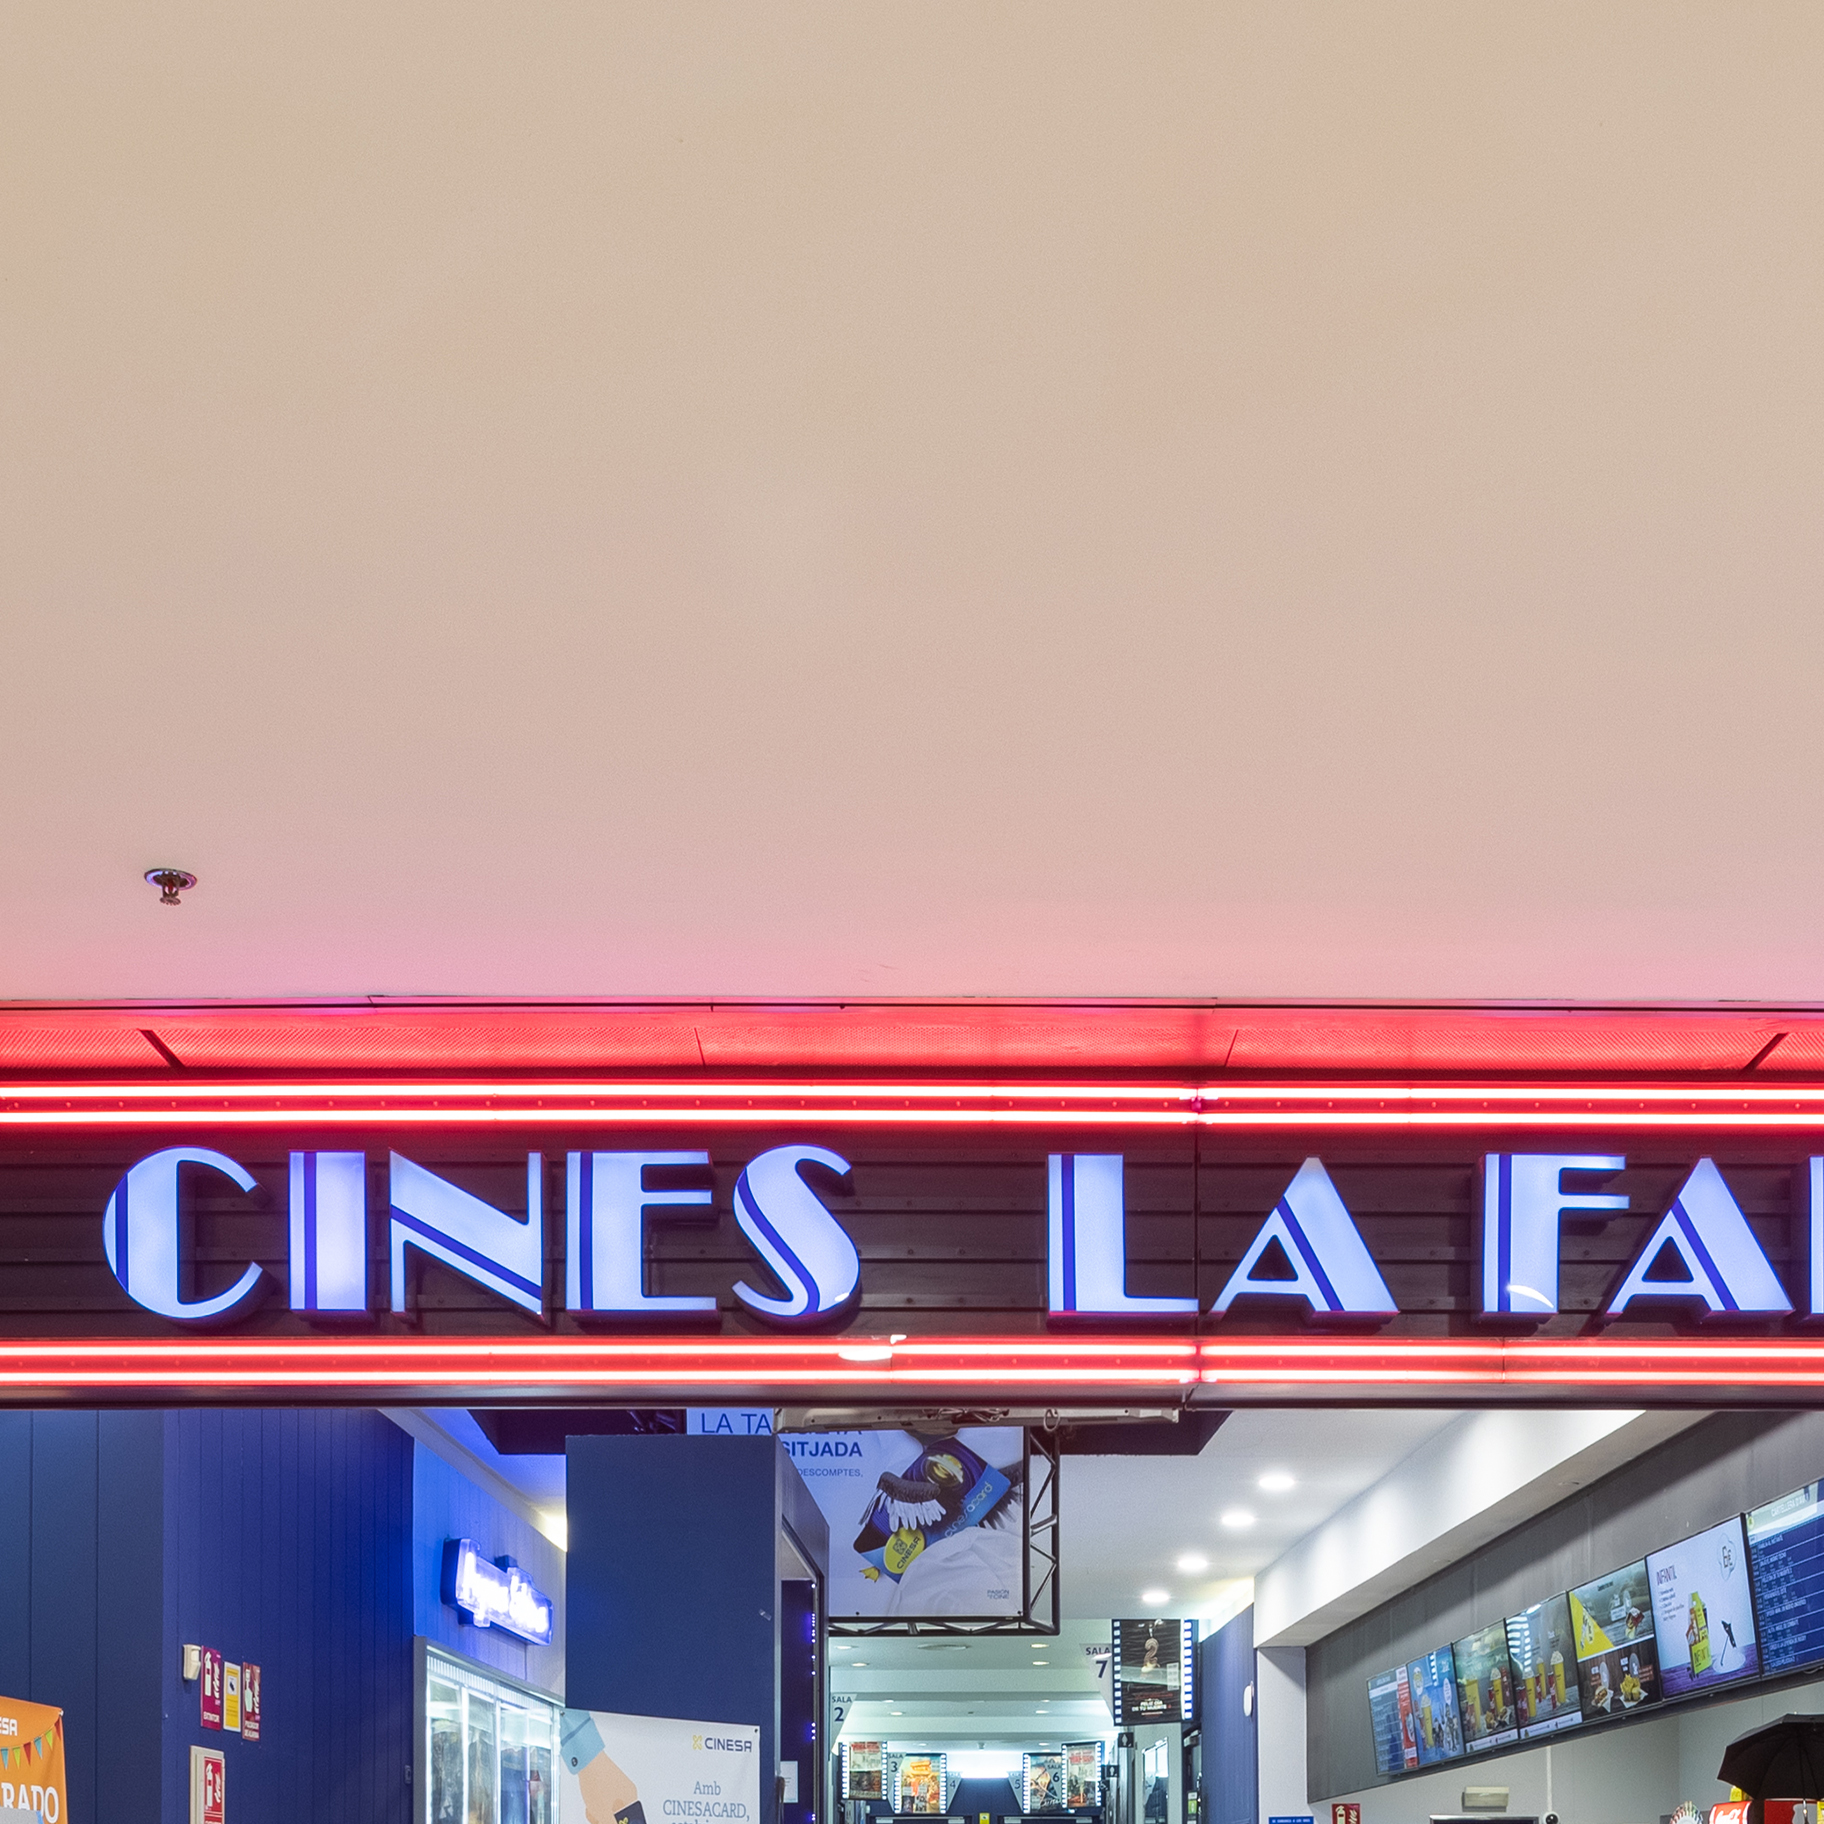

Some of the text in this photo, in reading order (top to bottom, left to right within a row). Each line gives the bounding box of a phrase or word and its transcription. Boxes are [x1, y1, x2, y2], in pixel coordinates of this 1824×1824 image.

[103, 1143, 860, 1320] CINES
[1047, 1152, 1400, 1316] LA
[701, 1413, 734, 1434] LA
[1086, 1647, 1112, 1656] SALA
[1096, 1660, 1108, 1679] 7
[832, 1695, 854, 1704] SALA
[834, 1707, 845, 1722] 2
[704, 1737, 754, 1754] CINESA
[890, 1761, 899, 1774] 3
[1052, 1772, 1060, 1784] 6
[693, 1781, 722, 1796] Amb
[662, 1801, 750, 1822] CINESACARD,
